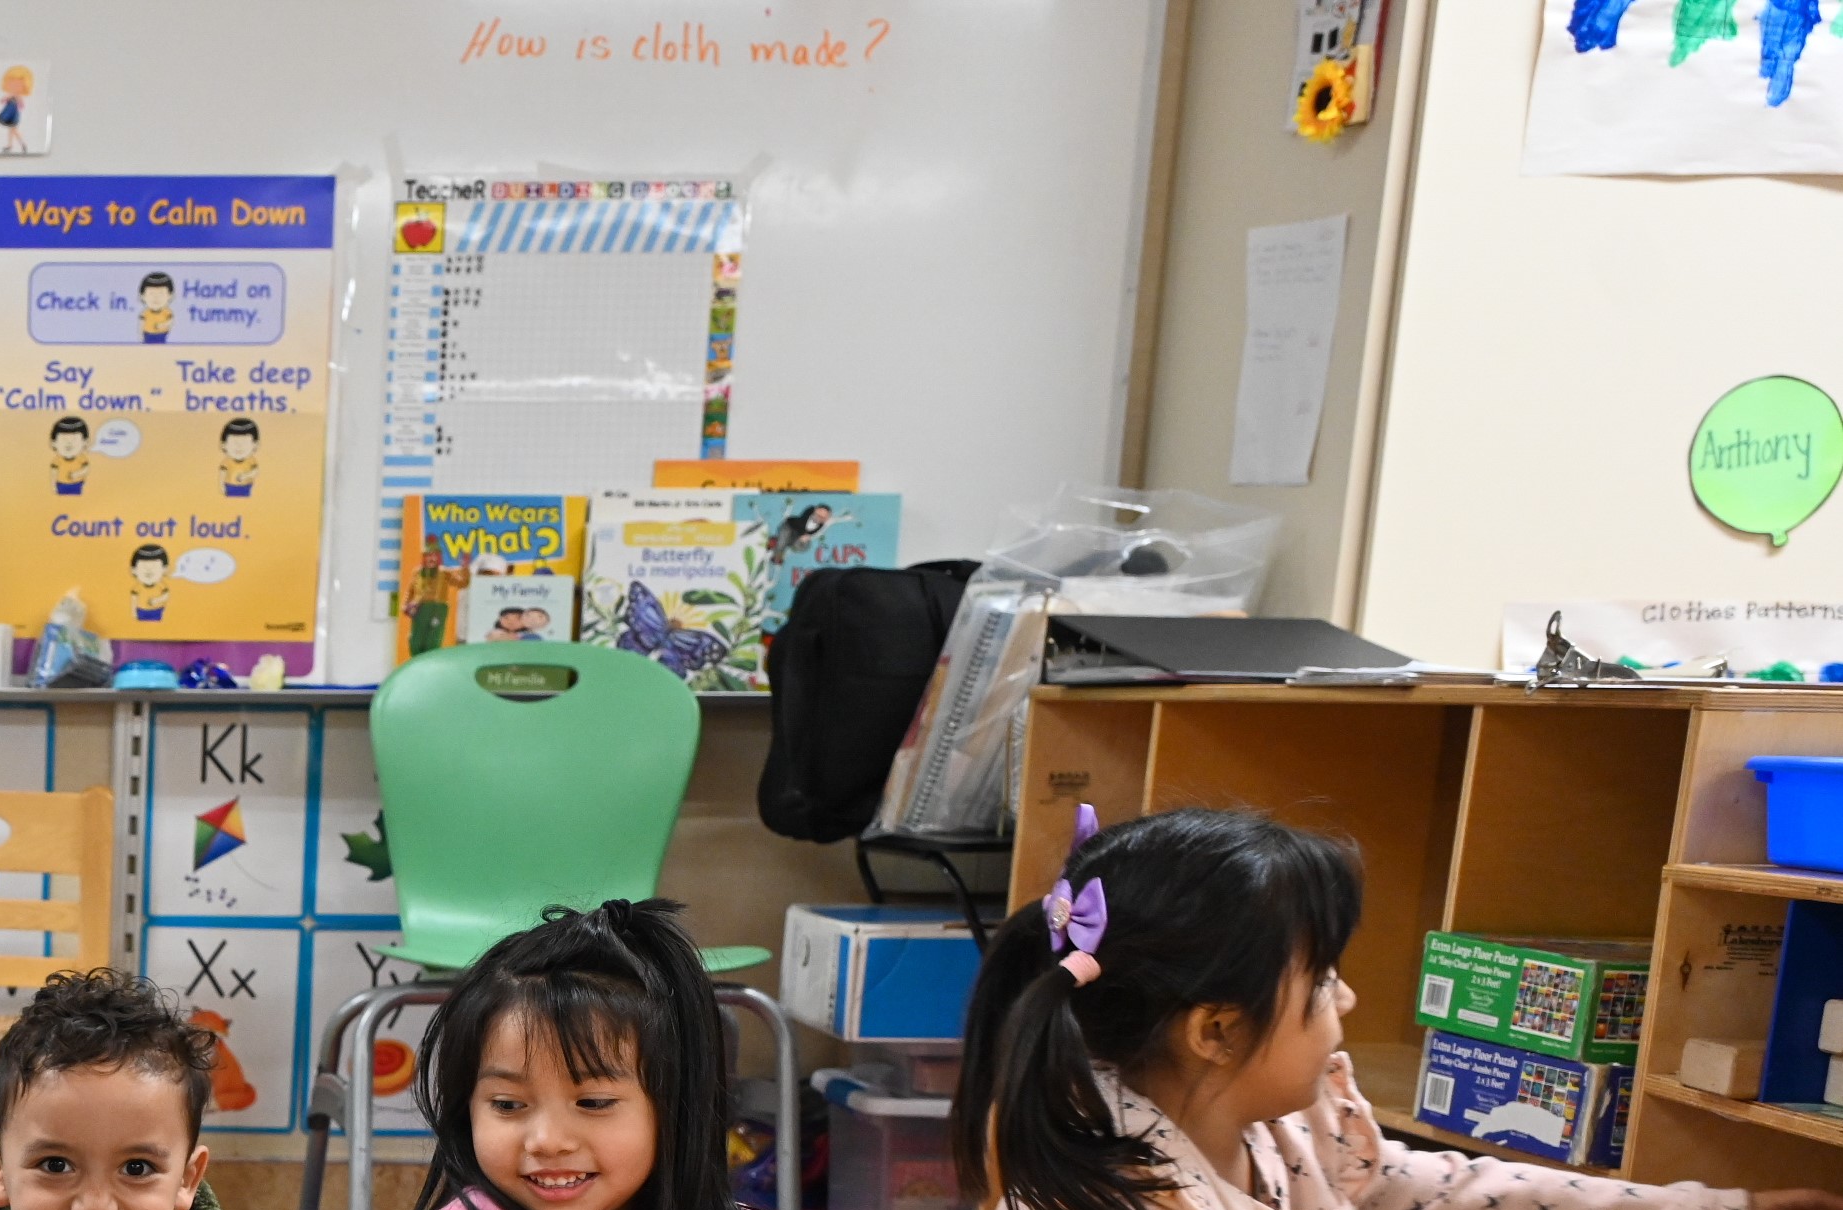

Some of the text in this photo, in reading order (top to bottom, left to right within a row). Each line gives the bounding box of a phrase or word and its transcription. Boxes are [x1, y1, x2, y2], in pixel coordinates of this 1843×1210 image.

[460, 18, 546, 63] How
[576, 34, 611, 61] is
[633, 22, 719, 67] cloth
[751, 29, 848, 68] made
[14, 198, 306, 234] Ways to Calm Down
[36, 291, 135, 312] Check in.
[182, 279, 271, 300] Hand on
[188, 305, 261, 330] tummy.
[44, 361, 94, 388] Say
[176, 360, 312, 389] Take deep
[185, 389, 297, 414] breaths.
[1698, 428, 1812, 480] Anthony
[50, 514, 251, 540] Count out loud.
[427, 502, 561, 527] Who Wears
[443, 527, 562, 560] What?
[641, 547, 715, 563] Butterfly
[815, 543, 866, 564] CAPS
[628, 564, 726, 580] La mariposa
[491, 583, 552, 598] My Family
[1642, 602, 1735, 623] Clothes
[199, 721, 265, 785] Kk
[185, 938, 257, 1000] Xx
